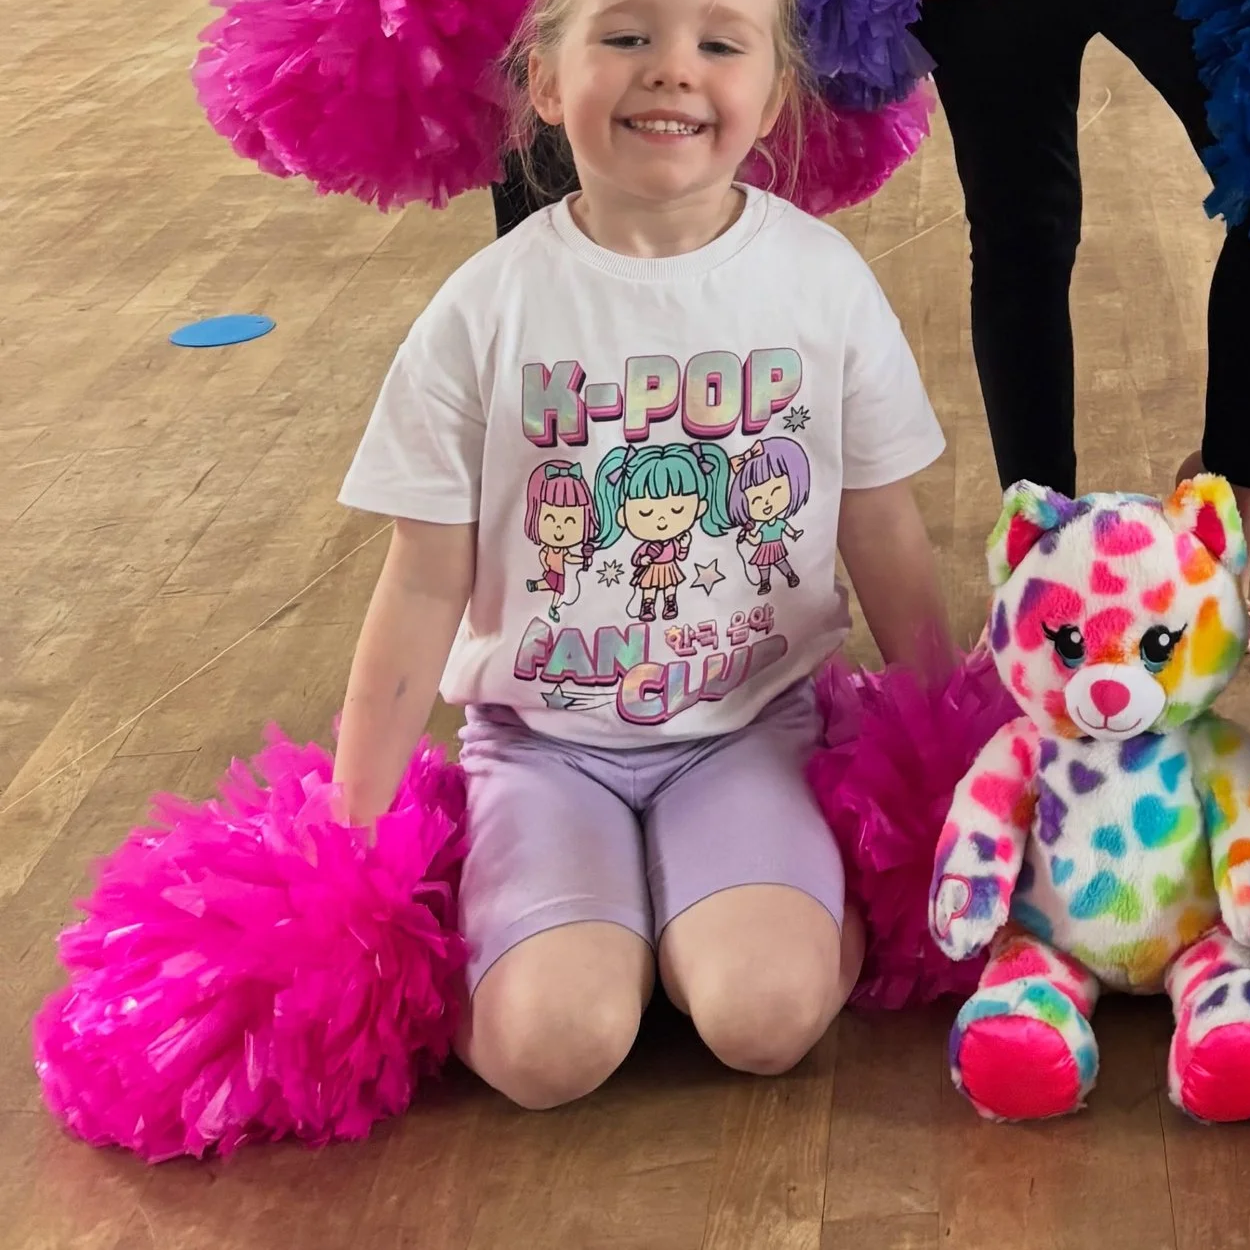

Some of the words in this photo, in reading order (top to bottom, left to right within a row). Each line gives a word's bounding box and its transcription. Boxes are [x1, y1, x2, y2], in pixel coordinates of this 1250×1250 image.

[521, 346, 804, 448] K-POP
[513, 615, 651, 687] FAN
[663, 618, 719, 658] 한국
[726, 602, 776, 646] 음악
